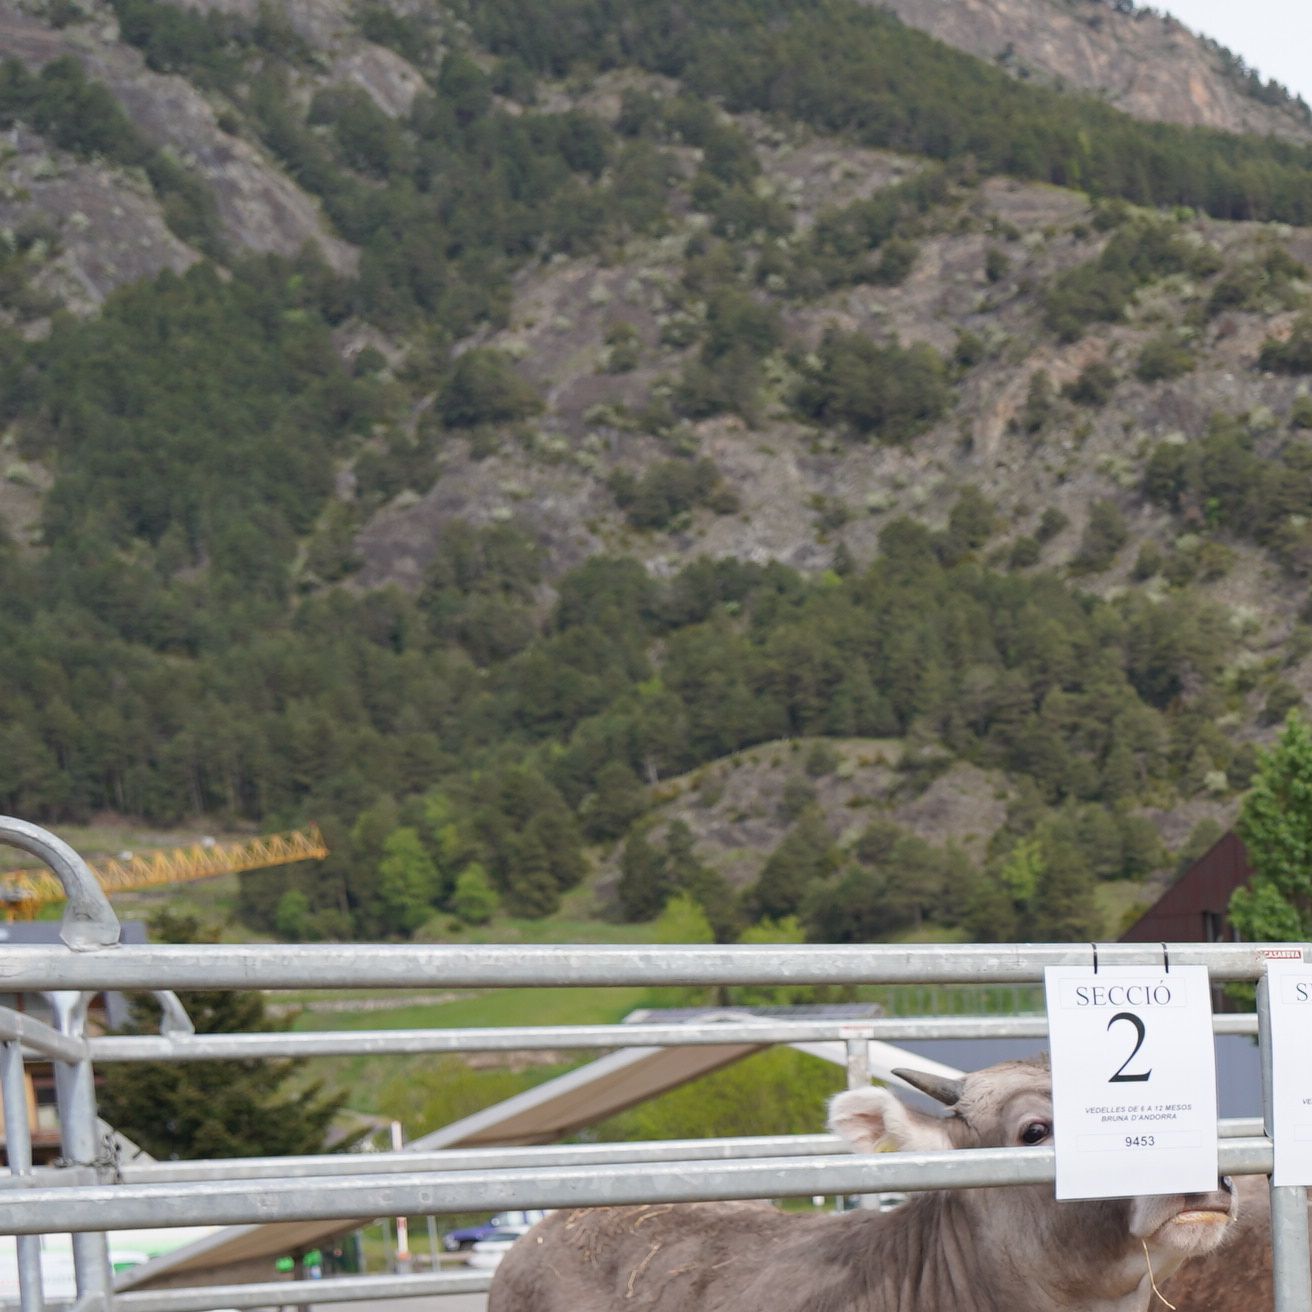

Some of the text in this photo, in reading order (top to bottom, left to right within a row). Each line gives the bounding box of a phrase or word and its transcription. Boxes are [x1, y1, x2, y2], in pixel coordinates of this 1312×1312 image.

[1075, 979, 1172, 1006] SECCIÓ
[1106, 1012, 1153, 1083] 2
[1085, 1105, 1126, 1114] VEDELLES
[1127, 1105, 1138, 1113] DE
[1164, 1103, 1192, 1111] MESOS
[1101, 1113, 1177, 1122] BRUNA D'ANDORRA
[1125, 1135, 1155, 1147] 9453
